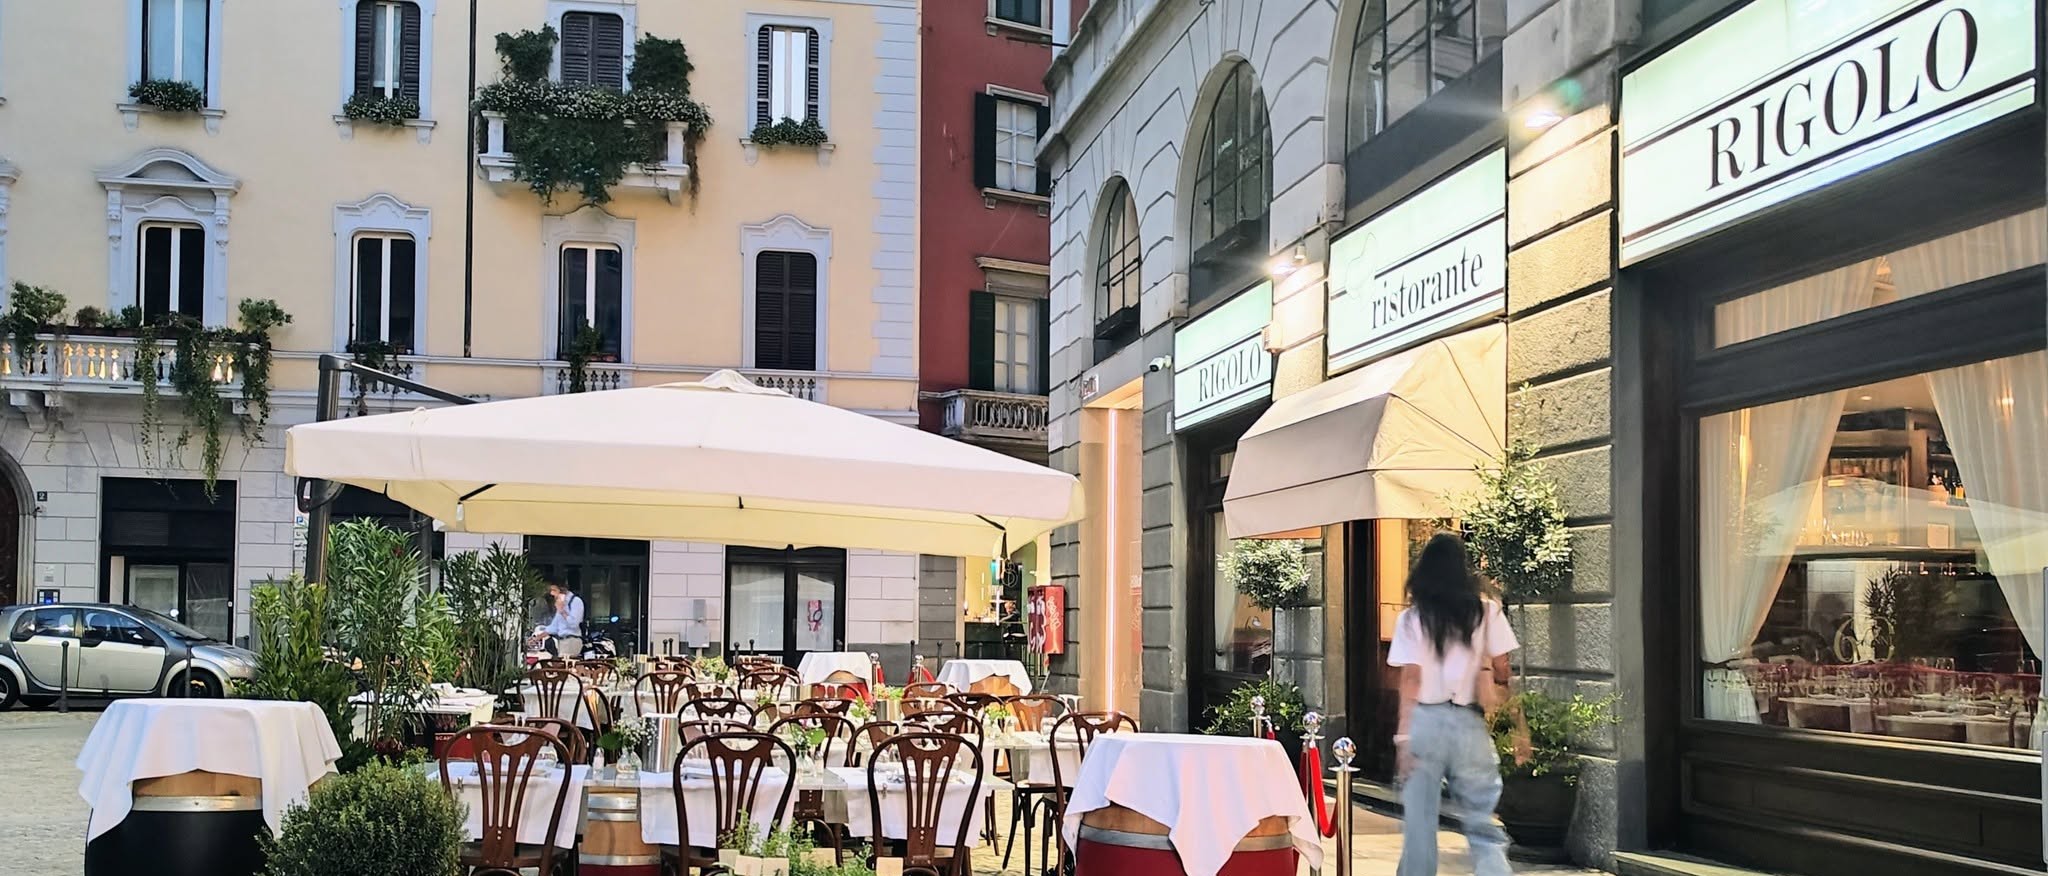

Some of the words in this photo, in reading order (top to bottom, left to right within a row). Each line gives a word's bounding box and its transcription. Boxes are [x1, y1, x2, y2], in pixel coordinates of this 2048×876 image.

[1706, 8, 1978, 191] RIGOLO
[1371, 246, 1483, 330] ristorante
[1198, 340, 1262, 402] RIGOLO
